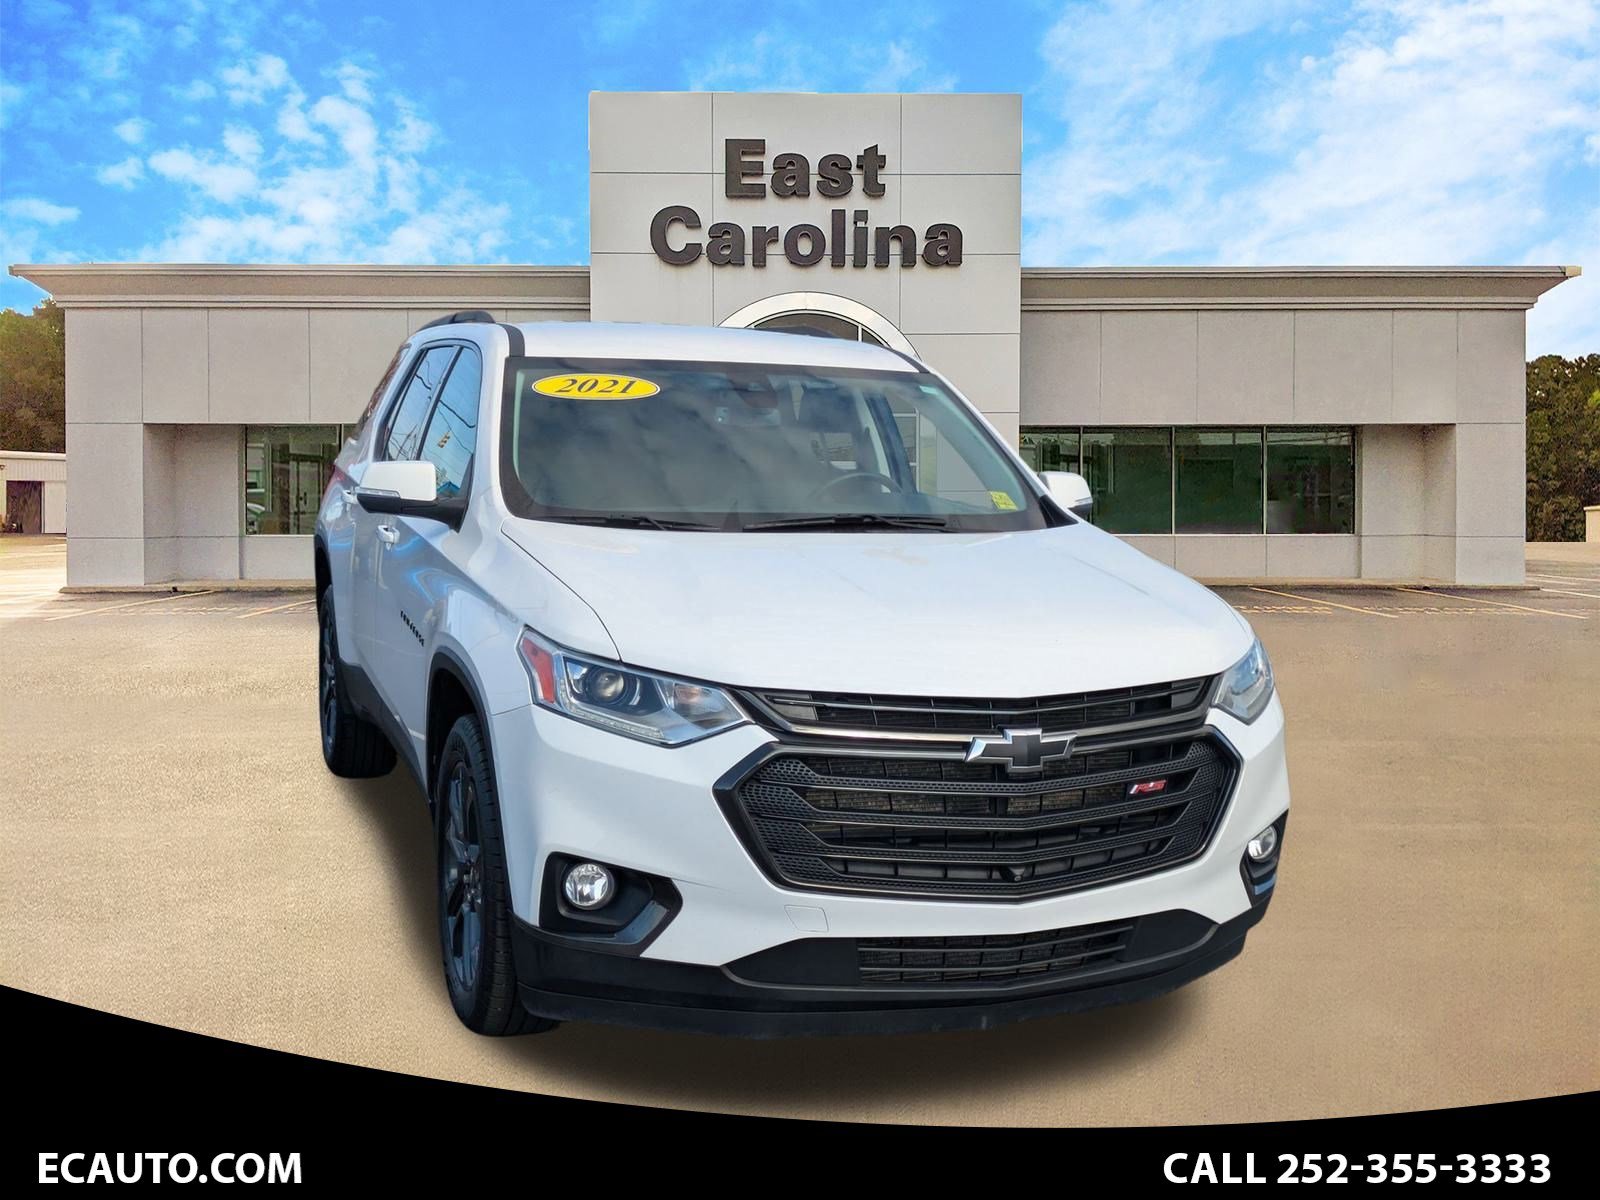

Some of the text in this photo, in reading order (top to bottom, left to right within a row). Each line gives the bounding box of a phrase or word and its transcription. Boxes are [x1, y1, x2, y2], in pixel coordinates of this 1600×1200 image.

[725, 138, 887, 198] East
[650, 205, 963, 267] Carolina
[555, 378, 637, 394] 2021
